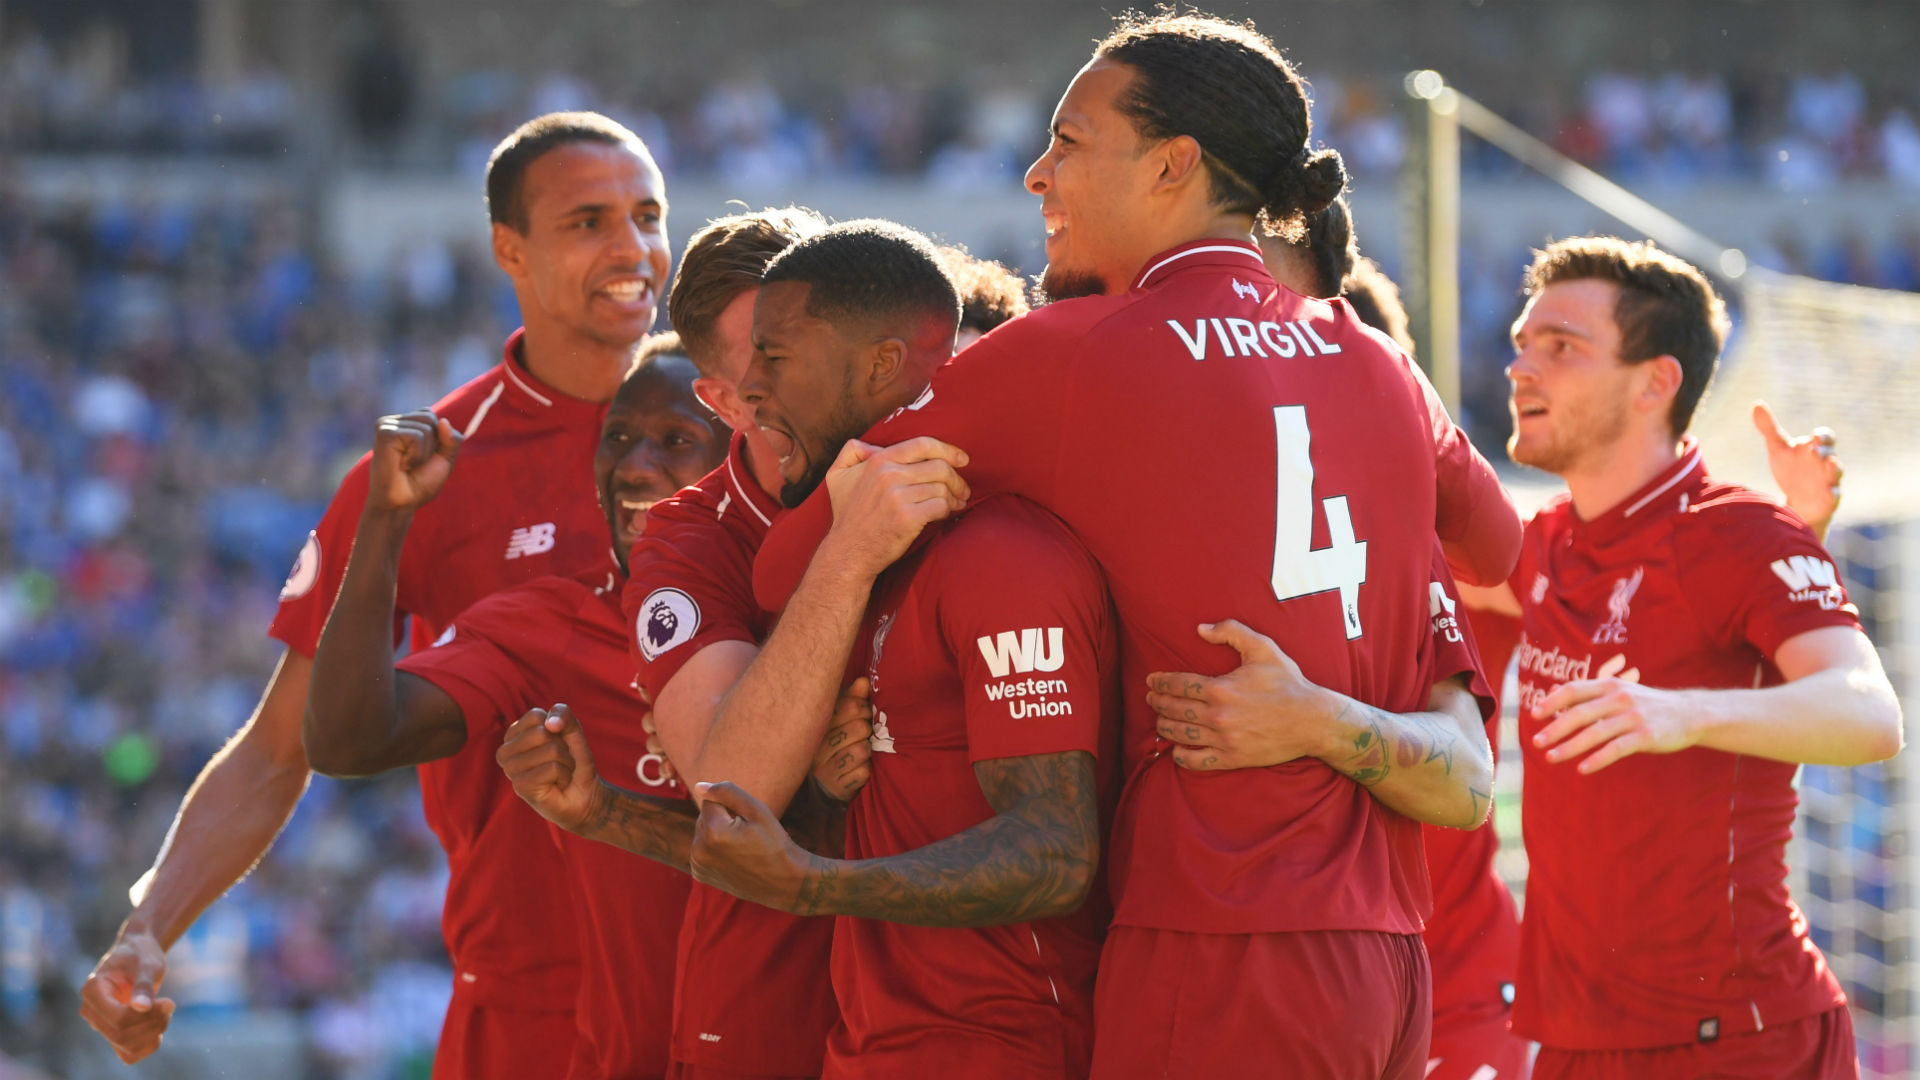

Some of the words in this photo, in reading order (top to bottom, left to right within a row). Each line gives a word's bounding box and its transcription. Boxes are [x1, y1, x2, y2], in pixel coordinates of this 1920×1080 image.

[1166, 317, 1342, 361] VIRGIL
[1271, 404, 1369, 641] 4
[976, 627, 1065, 678] WU
[984, 678, 1068, 702] Western
[1008, 696, 1073, 720] Union
